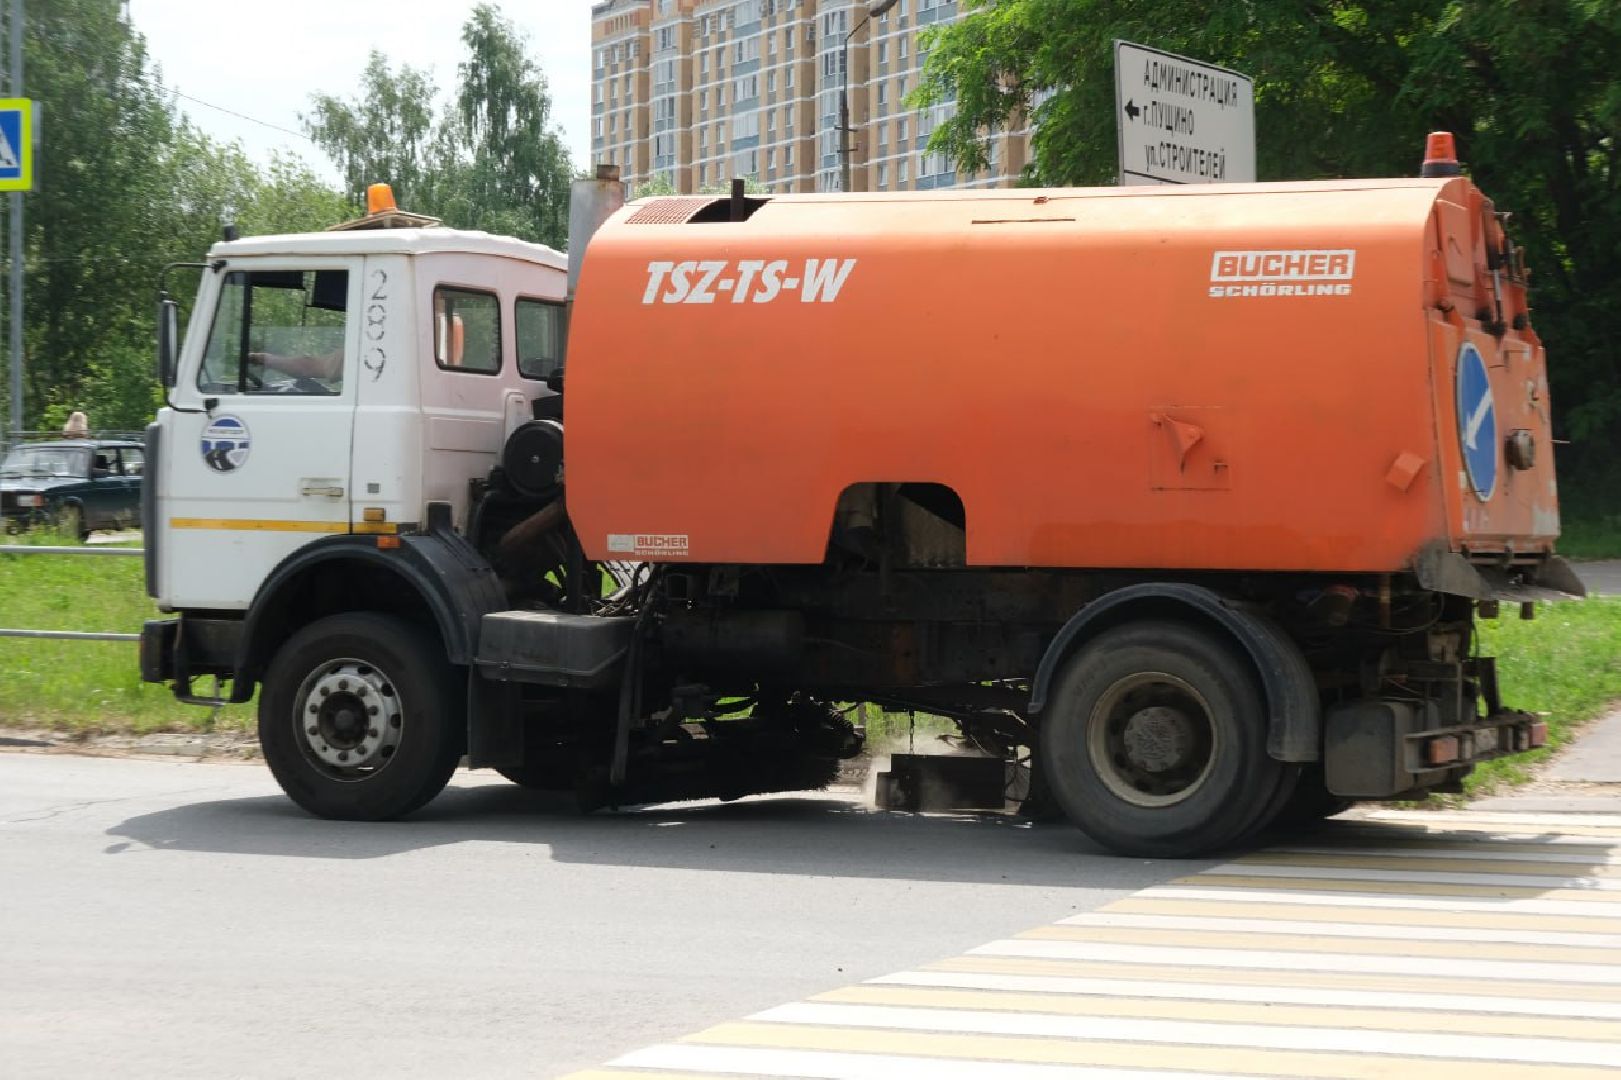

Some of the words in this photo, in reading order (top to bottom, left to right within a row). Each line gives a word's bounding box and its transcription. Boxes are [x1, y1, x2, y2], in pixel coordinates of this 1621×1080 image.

[1144, 59, 1238, 110] АДМИНИСТРАЦИЯ
[642, 258, 858, 304] TSZ-TS-W
[1216, 253, 1351, 278] BUCHER
[1208, 283, 1353, 297] SCHÖRLING
[364, 269, 387, 383] 2809
[637, 535, 688, 547] BUCHER
